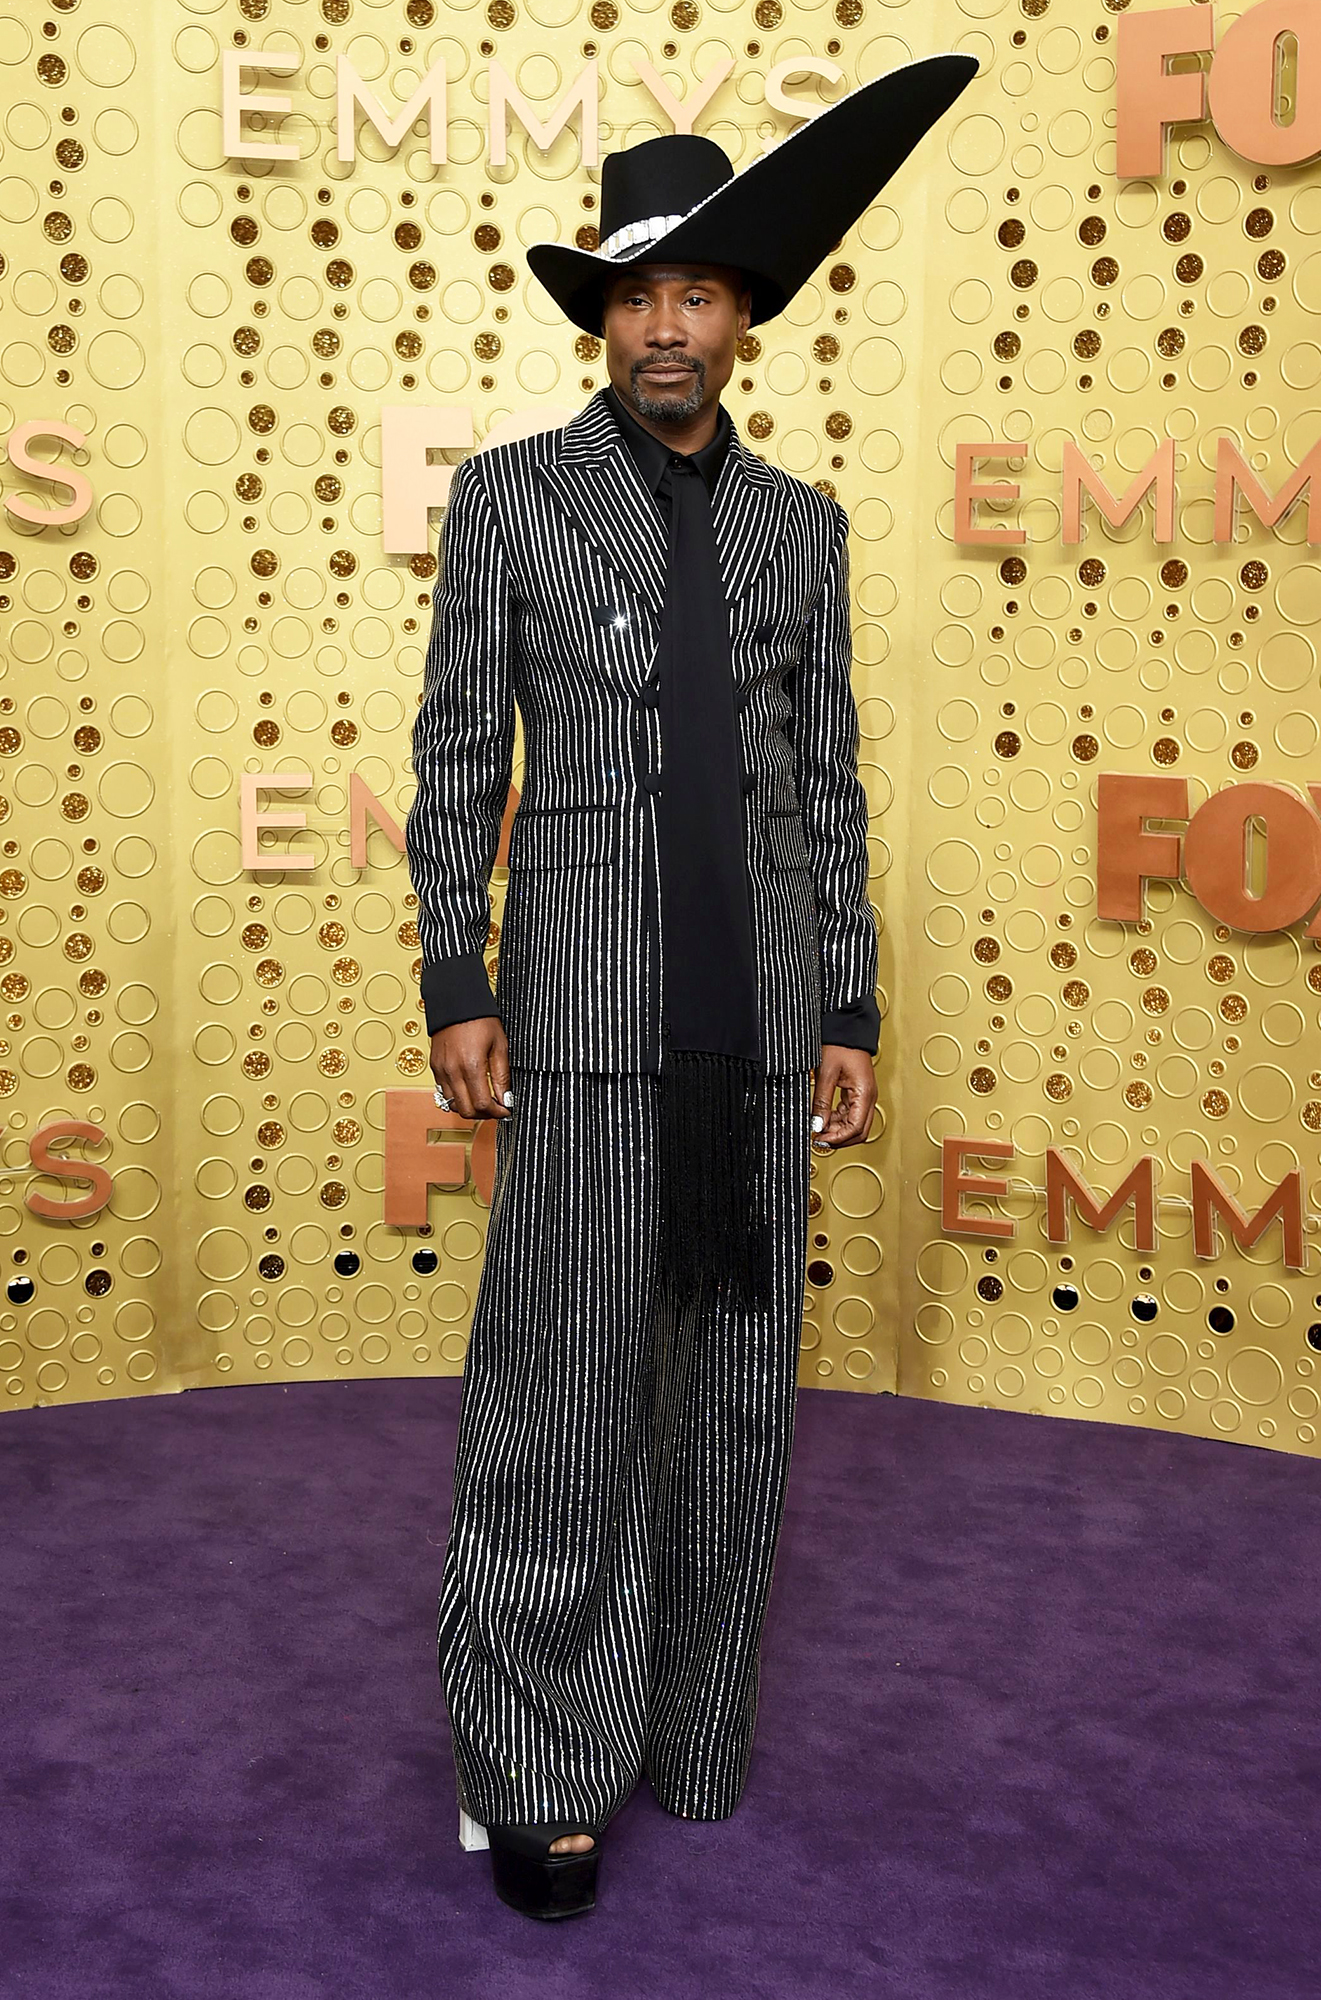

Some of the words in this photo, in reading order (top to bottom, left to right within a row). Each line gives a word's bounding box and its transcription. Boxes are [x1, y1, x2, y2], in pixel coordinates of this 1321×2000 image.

[381, 406, 579, 554] F
[954, 436, 1321, 544] EMM
[1097, 773, 1321, 939] FO
[384, 1090, 497, 1226] F
[941, 1135, 1306, 1268] EMM
